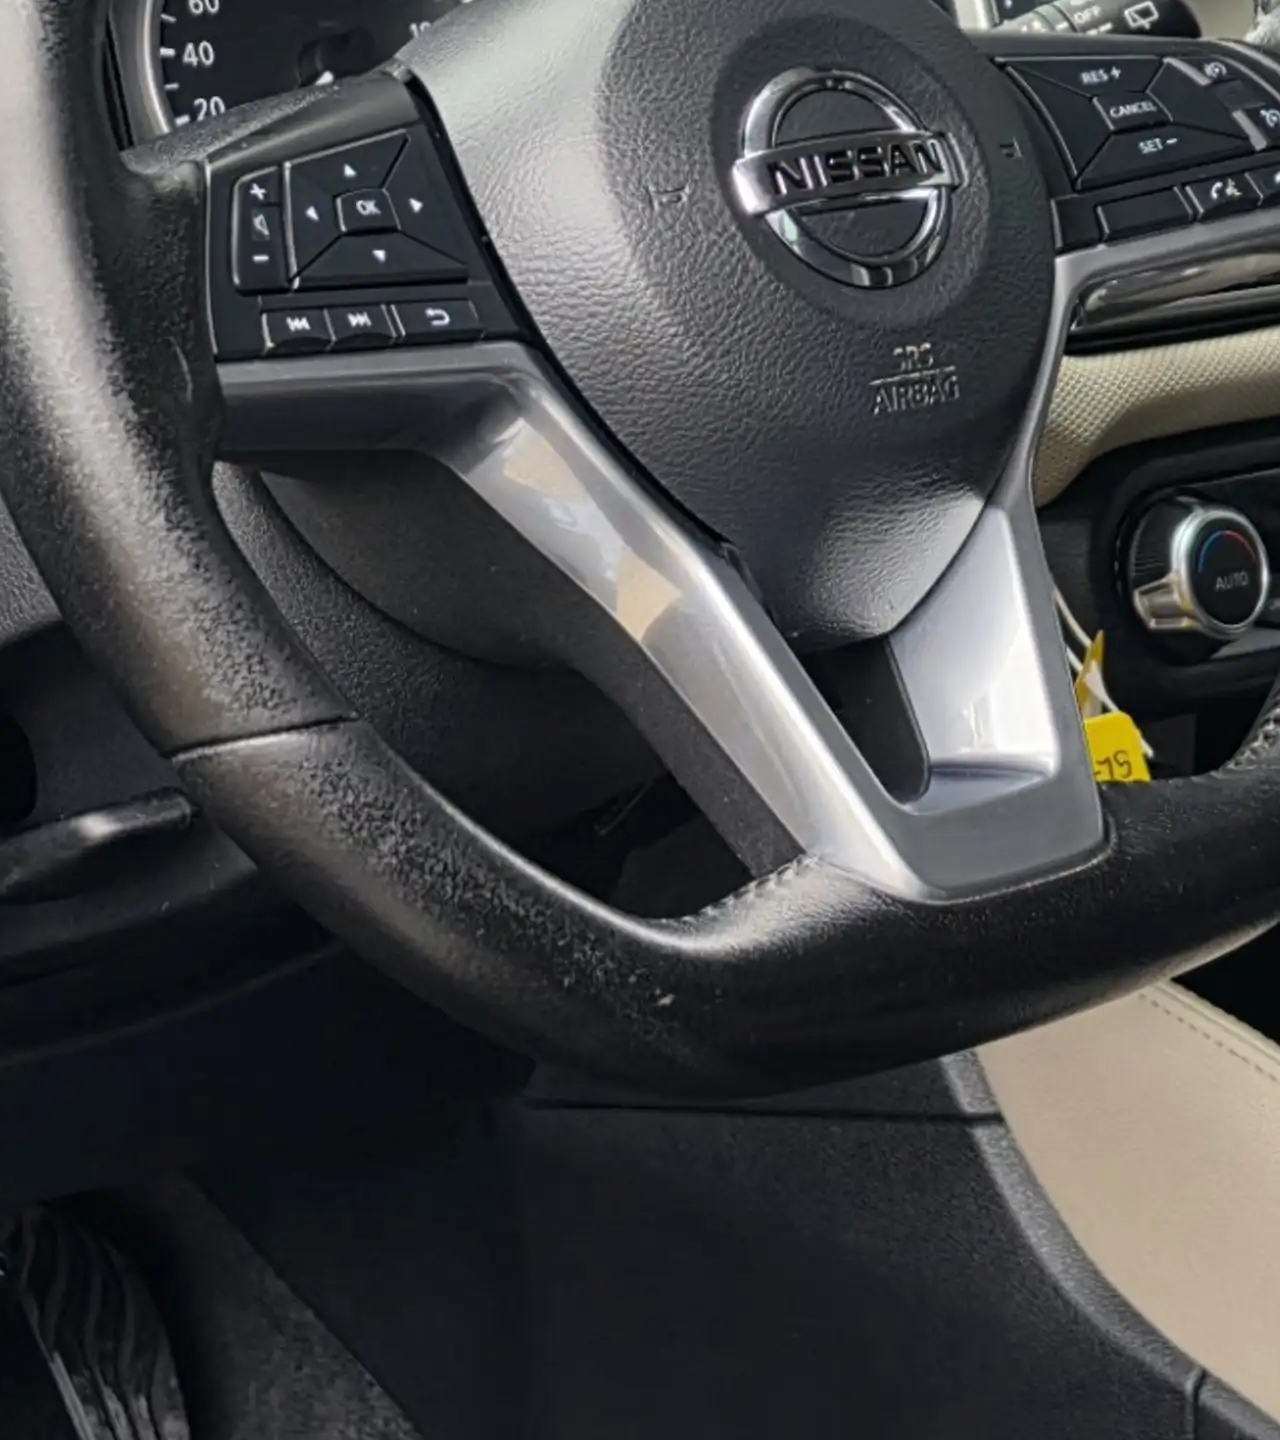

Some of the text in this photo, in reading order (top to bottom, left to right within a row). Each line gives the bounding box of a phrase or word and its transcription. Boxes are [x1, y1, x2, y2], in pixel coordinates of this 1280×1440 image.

[1074, 5, 1102, 25] OFF
[181, 40, 215, 67] 40
[1080, 70, 1109, 84] RES
[193, 95, 225, 120] 20
[1108, 99, 1159, 118] CANCEL
[1137, 139, 1165, 155] SET
[766, 137, 946, 196] NISSAN
[355, 198, 381, 217] OK
[872, 375, 960, 415] AIRBAG
[1214, 571, 1250, 593] AUTO
